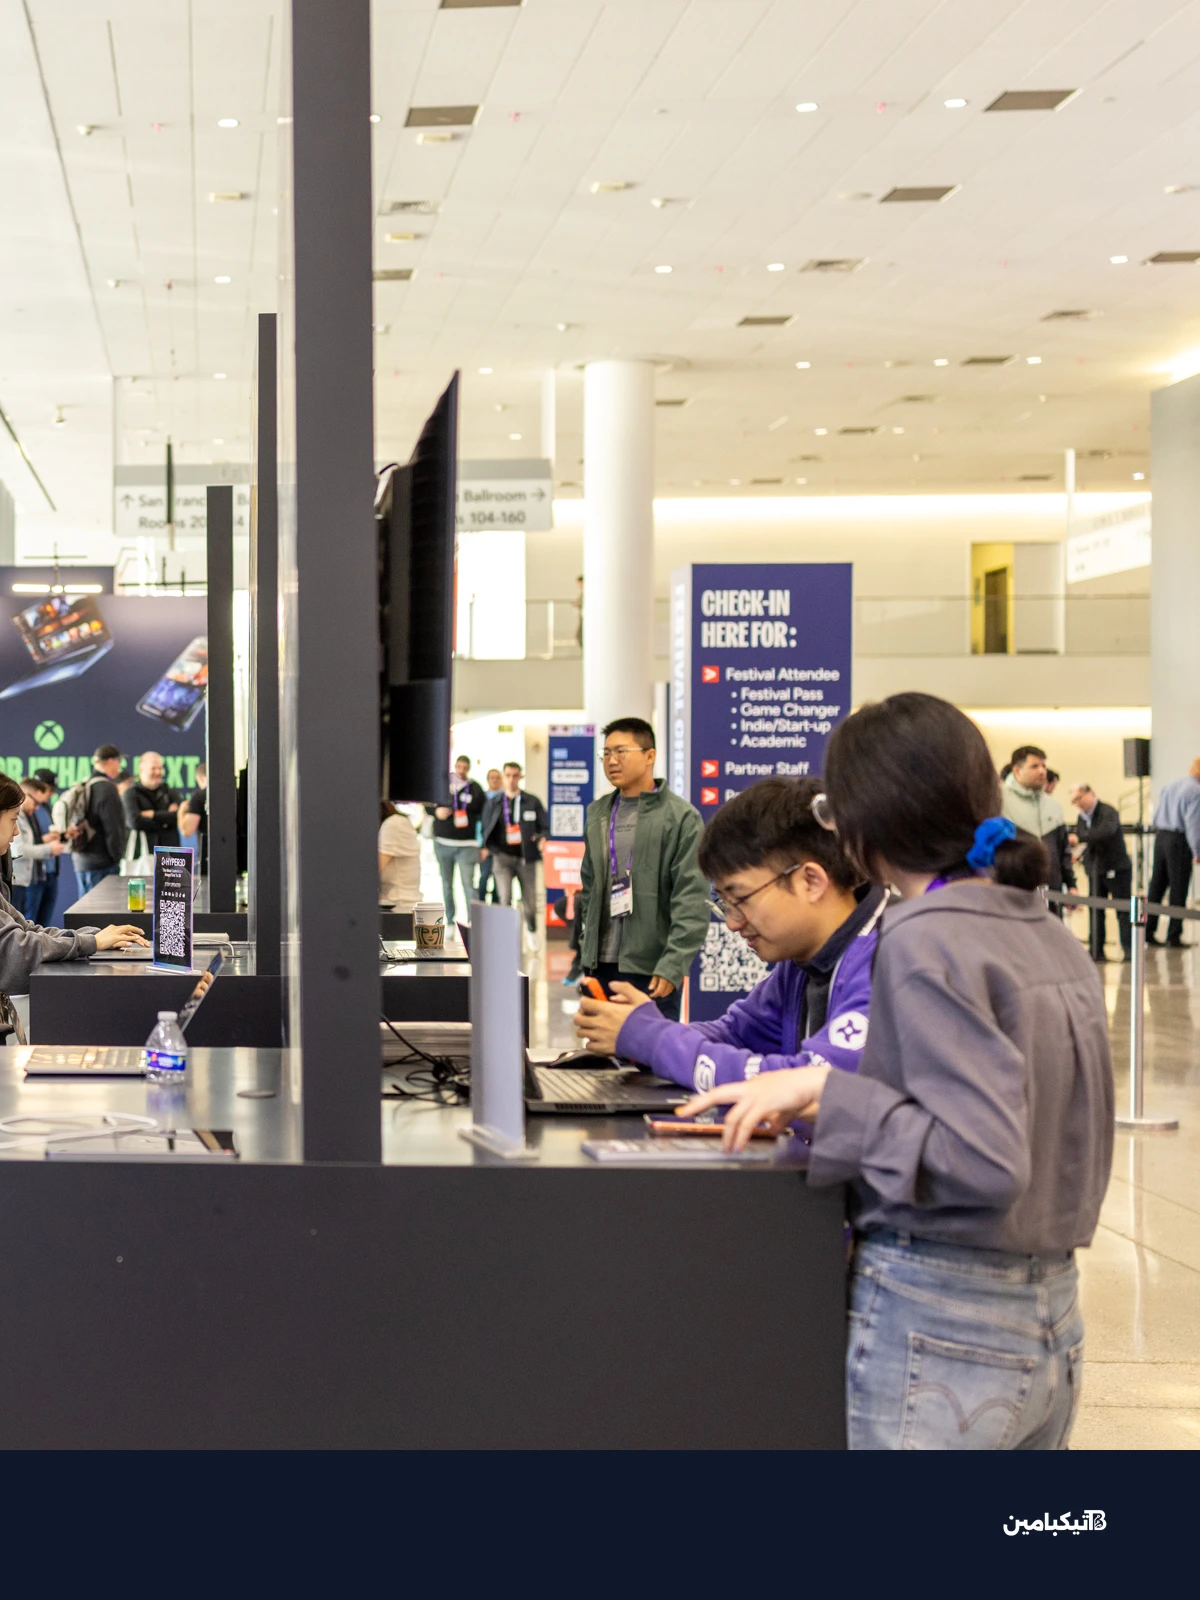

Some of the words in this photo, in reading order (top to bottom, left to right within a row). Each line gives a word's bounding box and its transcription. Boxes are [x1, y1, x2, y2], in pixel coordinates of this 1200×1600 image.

[464, 490, 527, 502] Ballroom
[701, 589, 791, 617] CHECK-IN
[701, 621, 750, 648] HERE
[725, 667, 776, 681] Festival
[777, 667, 840, 681] Attendee
[741, 687, 791, 701] Festival
[793, 687, 824, 701] Pass
[740, 702, 781, 717] Game
[782, 702, 841, 720] Changer
[741, 718, 832, 735] Indie/Start-up
[740, 733, 807, 748] Academic
[725, 761, 774, 775] Partner
[775, 761, 810, 775] Staff
